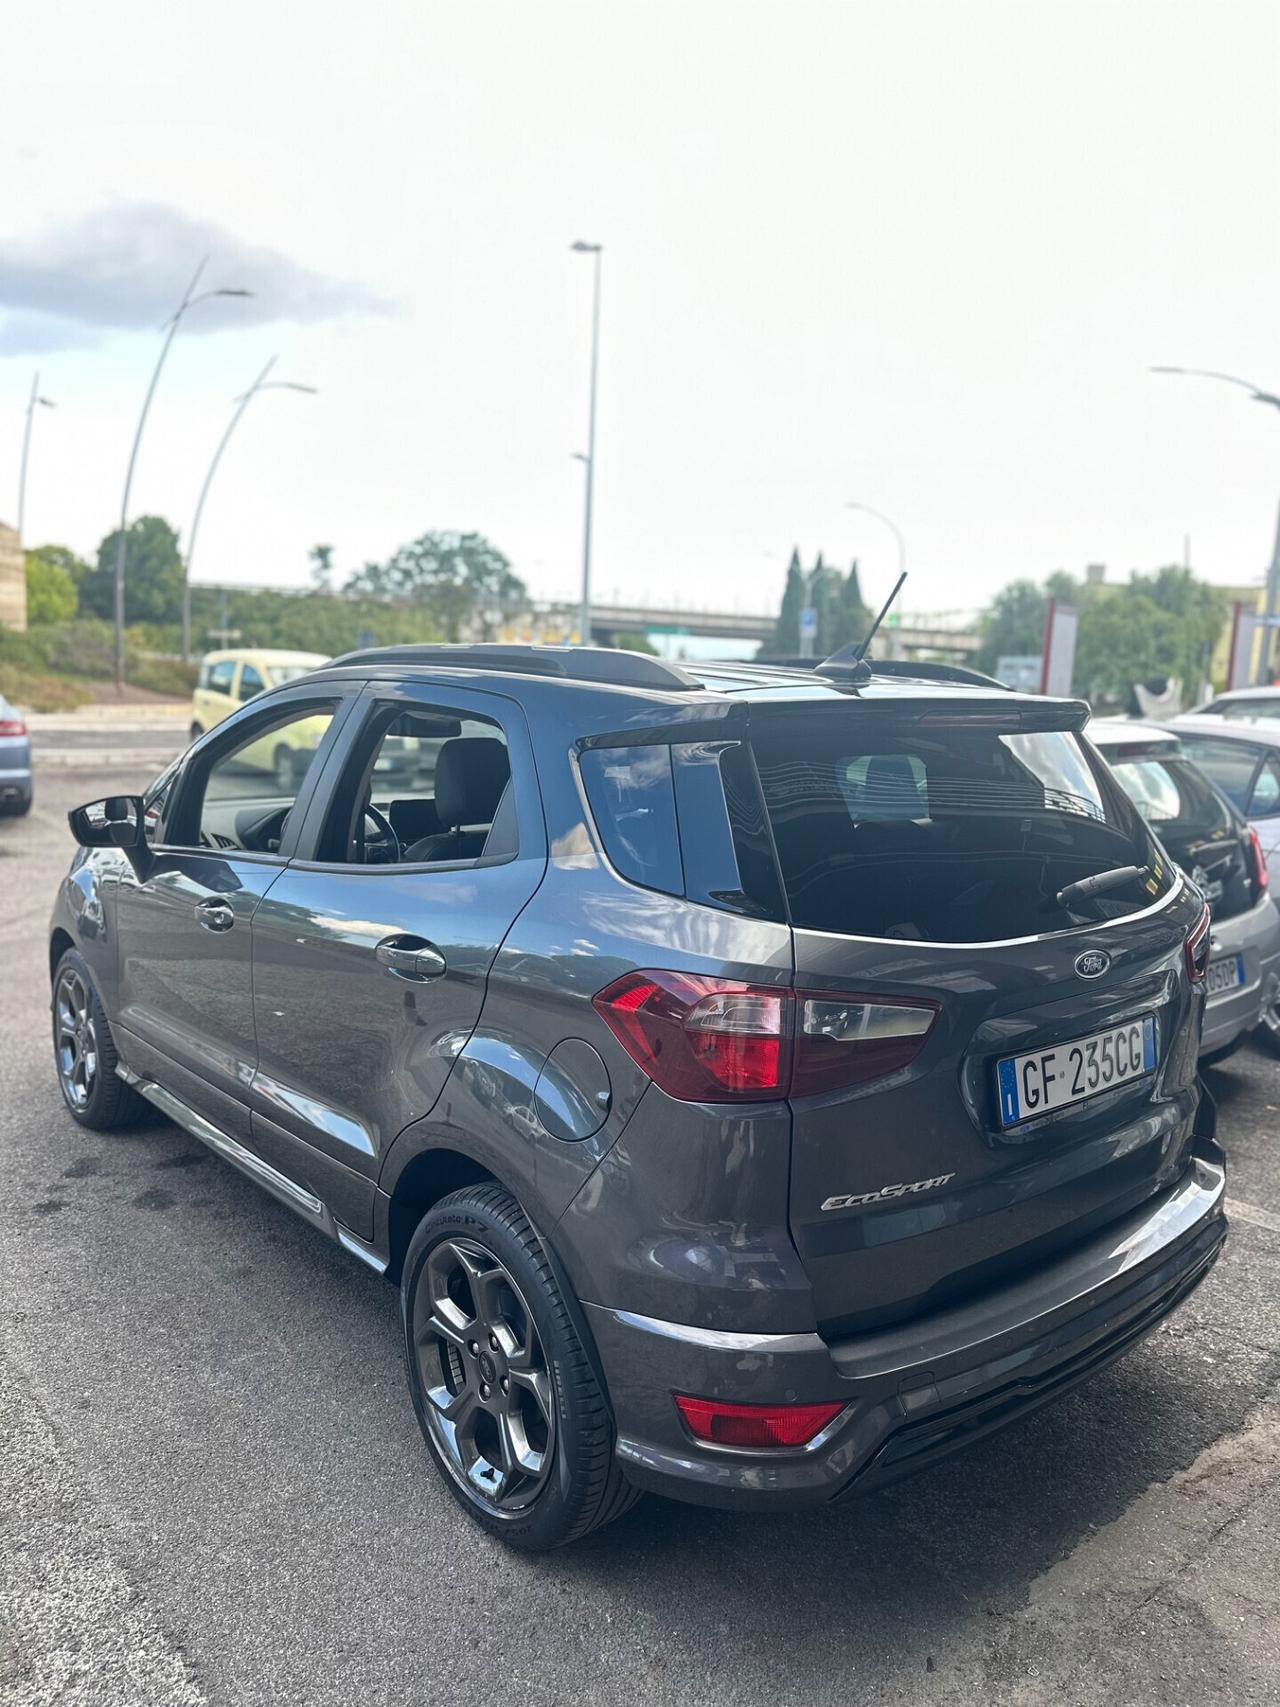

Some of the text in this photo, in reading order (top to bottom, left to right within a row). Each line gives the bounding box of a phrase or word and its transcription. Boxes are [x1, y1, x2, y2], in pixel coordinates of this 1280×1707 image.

[1081, 955, 1103, 973] Ford
[1022, 1025, 1142, 1109] GF 235CG
